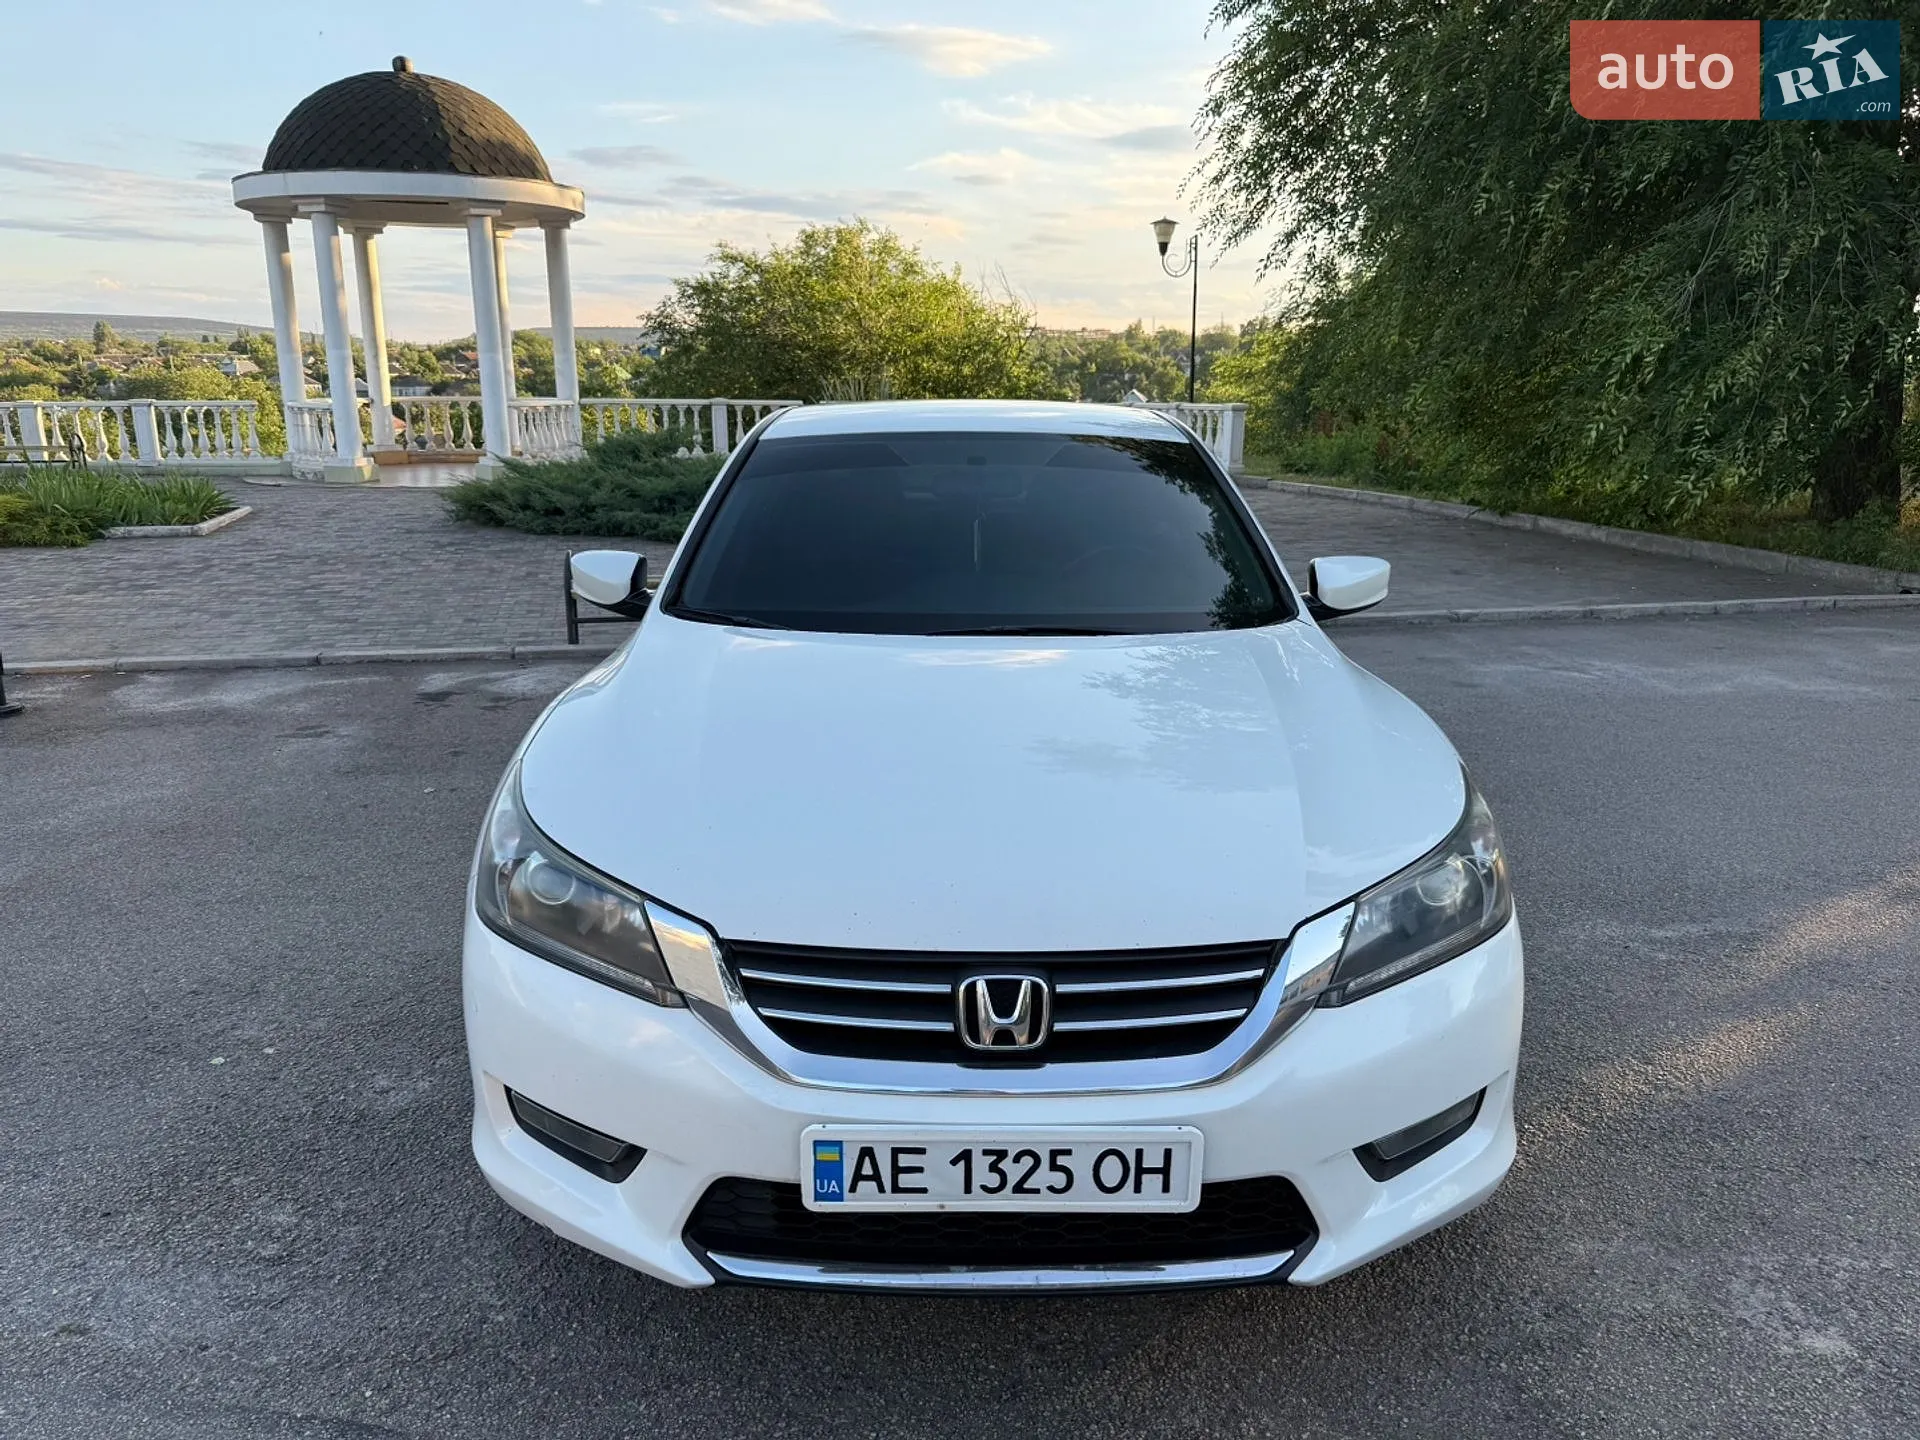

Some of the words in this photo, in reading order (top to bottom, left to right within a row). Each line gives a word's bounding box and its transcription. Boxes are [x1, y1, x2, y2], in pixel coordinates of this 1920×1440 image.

[816, 1179, 840, 1194] UA
[848, 1146, 929, 1194] AE
[949, 1148, 1074, 1195] 1325
[1092, 1147, 1172, 1194] OH
